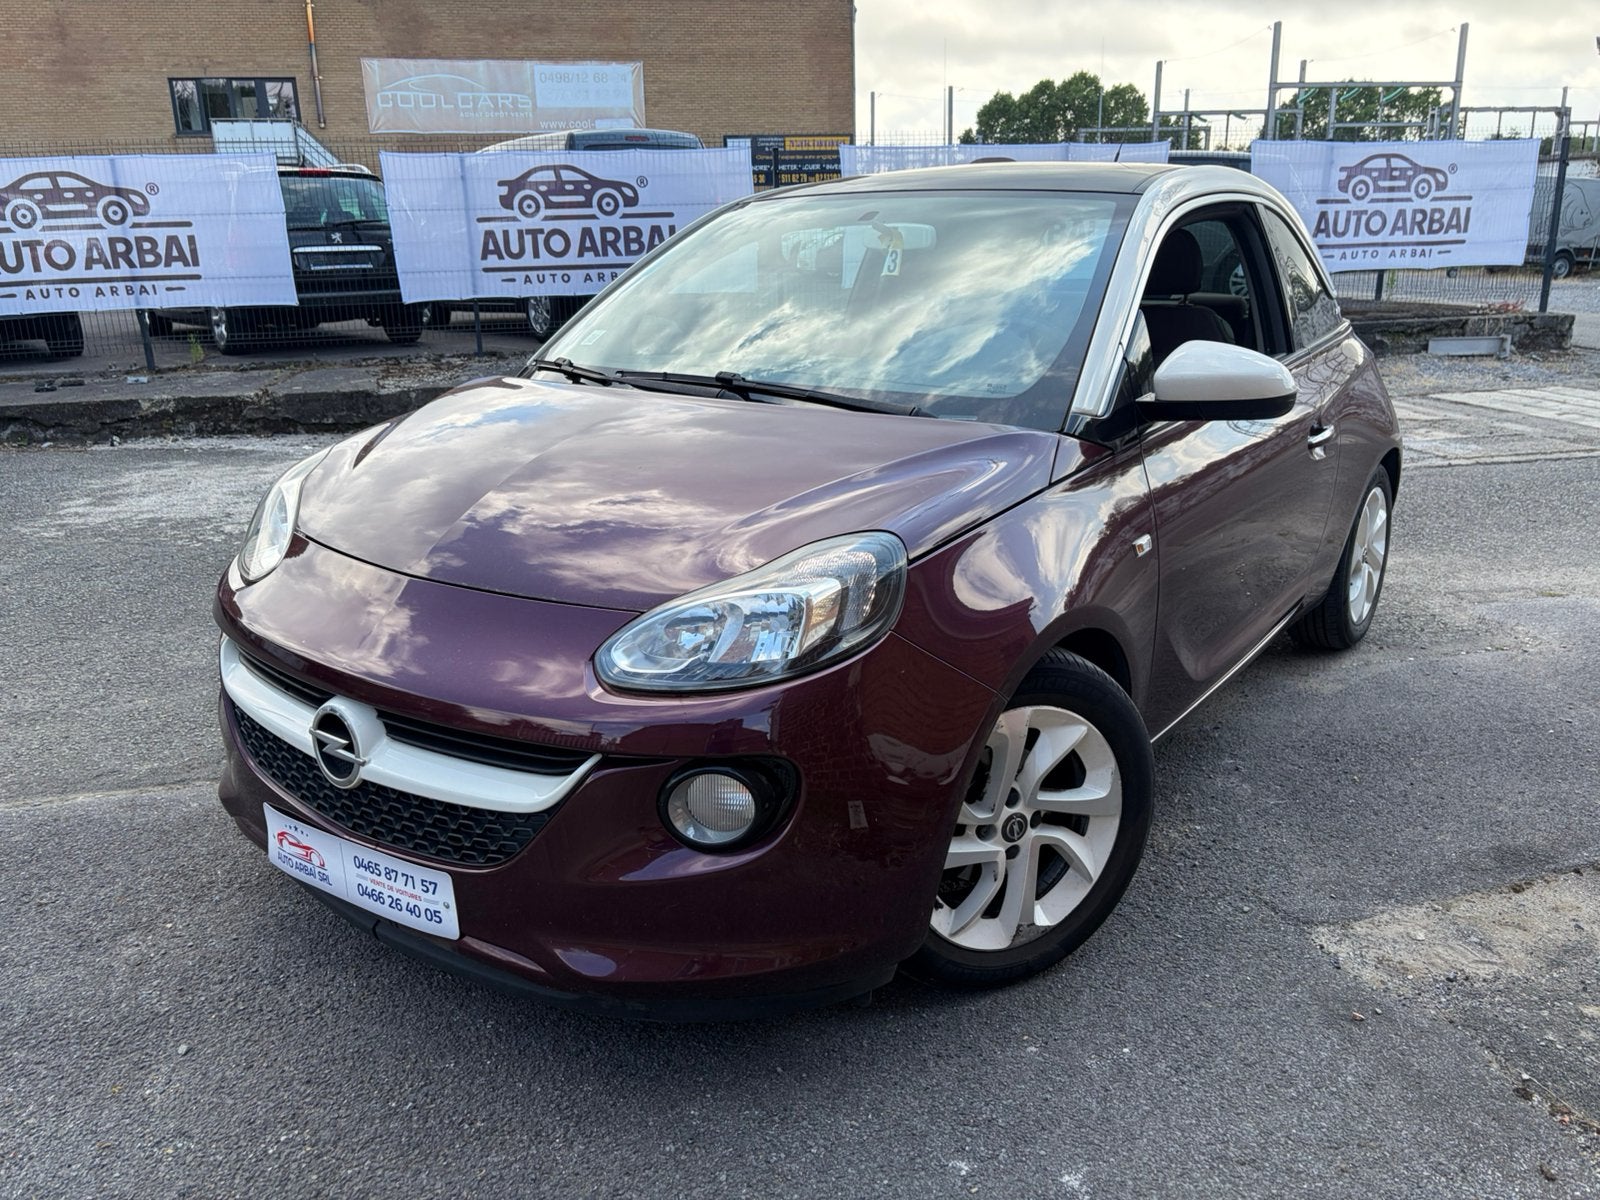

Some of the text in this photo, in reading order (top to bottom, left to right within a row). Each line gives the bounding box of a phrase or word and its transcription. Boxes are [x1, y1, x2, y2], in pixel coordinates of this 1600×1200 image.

[540, 72, 588, 84] 0498/12
[593, 72, 609, 84] 68
[1312, 206, 1471, 238] AUTO ARBAI
[0, 234, 200, 274] UTO ARBAI
[480, 228, 572, 261] AUTO
[1340, 248, 1432, 261] AUTO ARBAI
[887, 249, 899, 273] 3
[26, 284, 158, 300] AUTO ARBAI
[523, 271, 618, 285] AUTO ARB
[278, 851, 294, 868] AUTO
[317, 871, 333, 886] SRL
[353, 855, 438, 895] 0465 87 71 57
[357, 883, 443, 924] 0466 26 40 05
